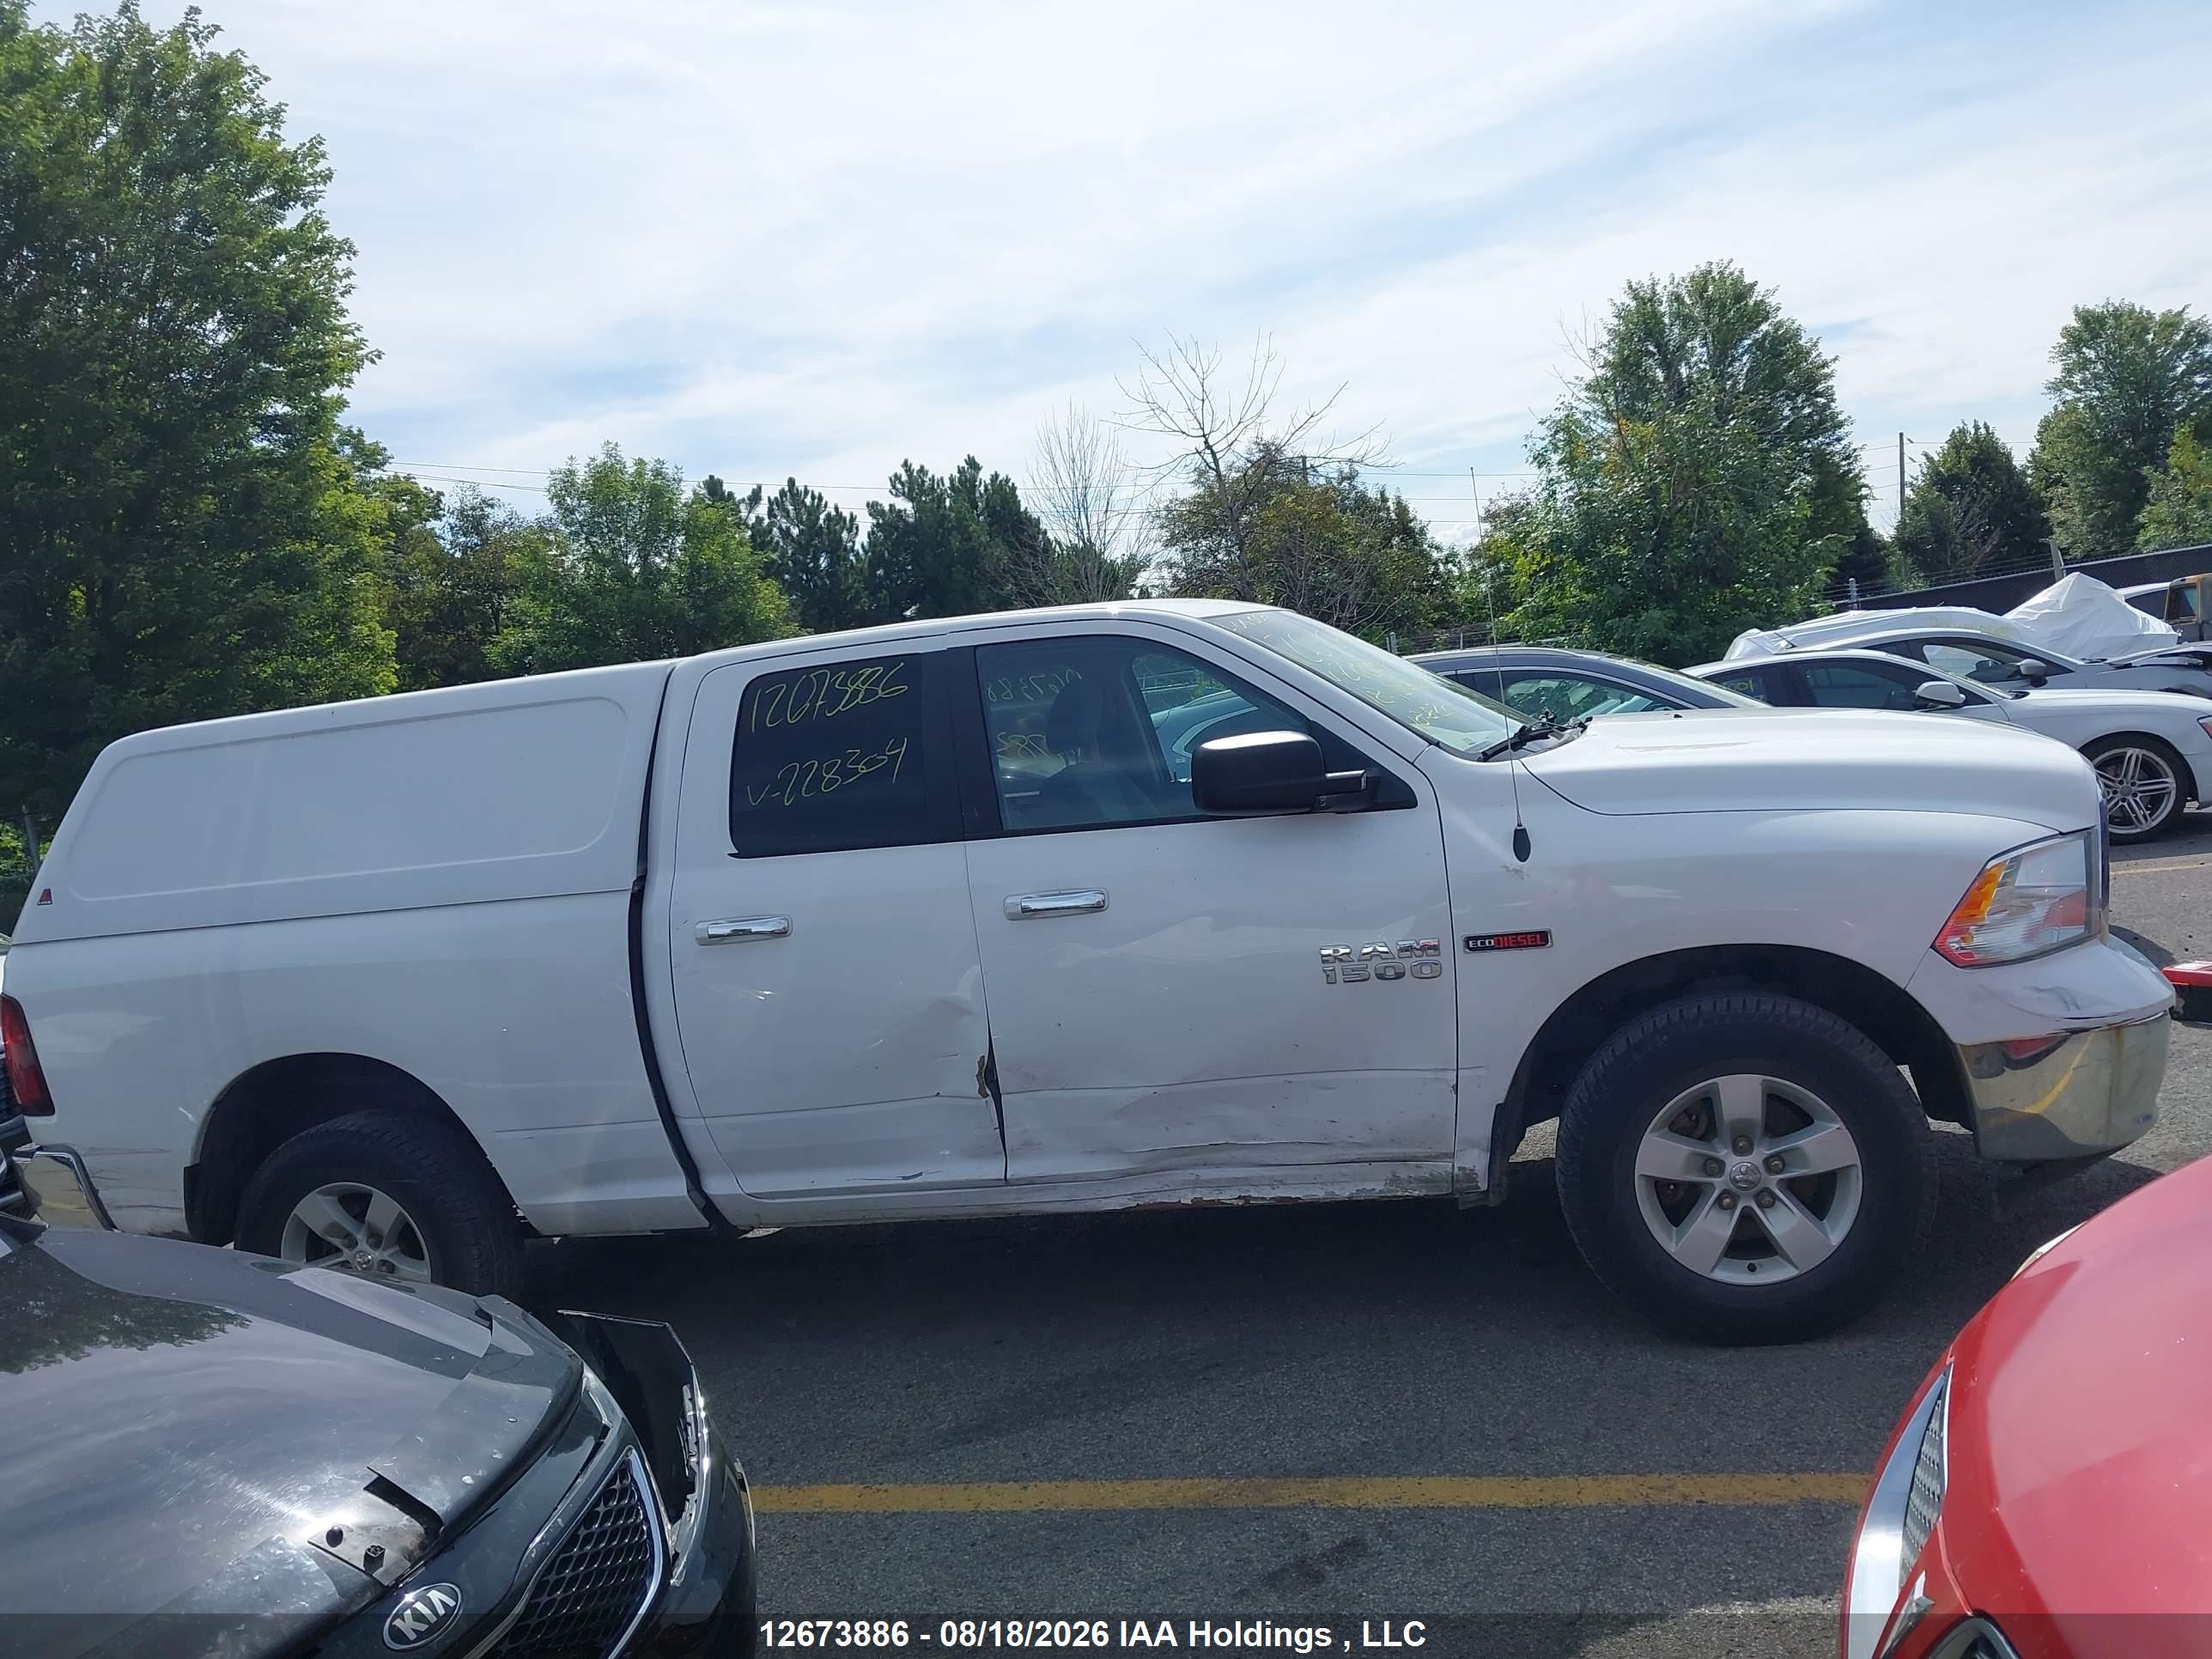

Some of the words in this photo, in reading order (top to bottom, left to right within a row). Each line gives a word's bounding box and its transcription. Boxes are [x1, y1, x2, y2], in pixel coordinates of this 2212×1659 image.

[1319, 937, 1442, 964] RAM
[1468, 932, 1545, 950] ECODIESEL
[1322, 959, 1443, 985] 1500
[392, 1589, 457, 1642] KIA
